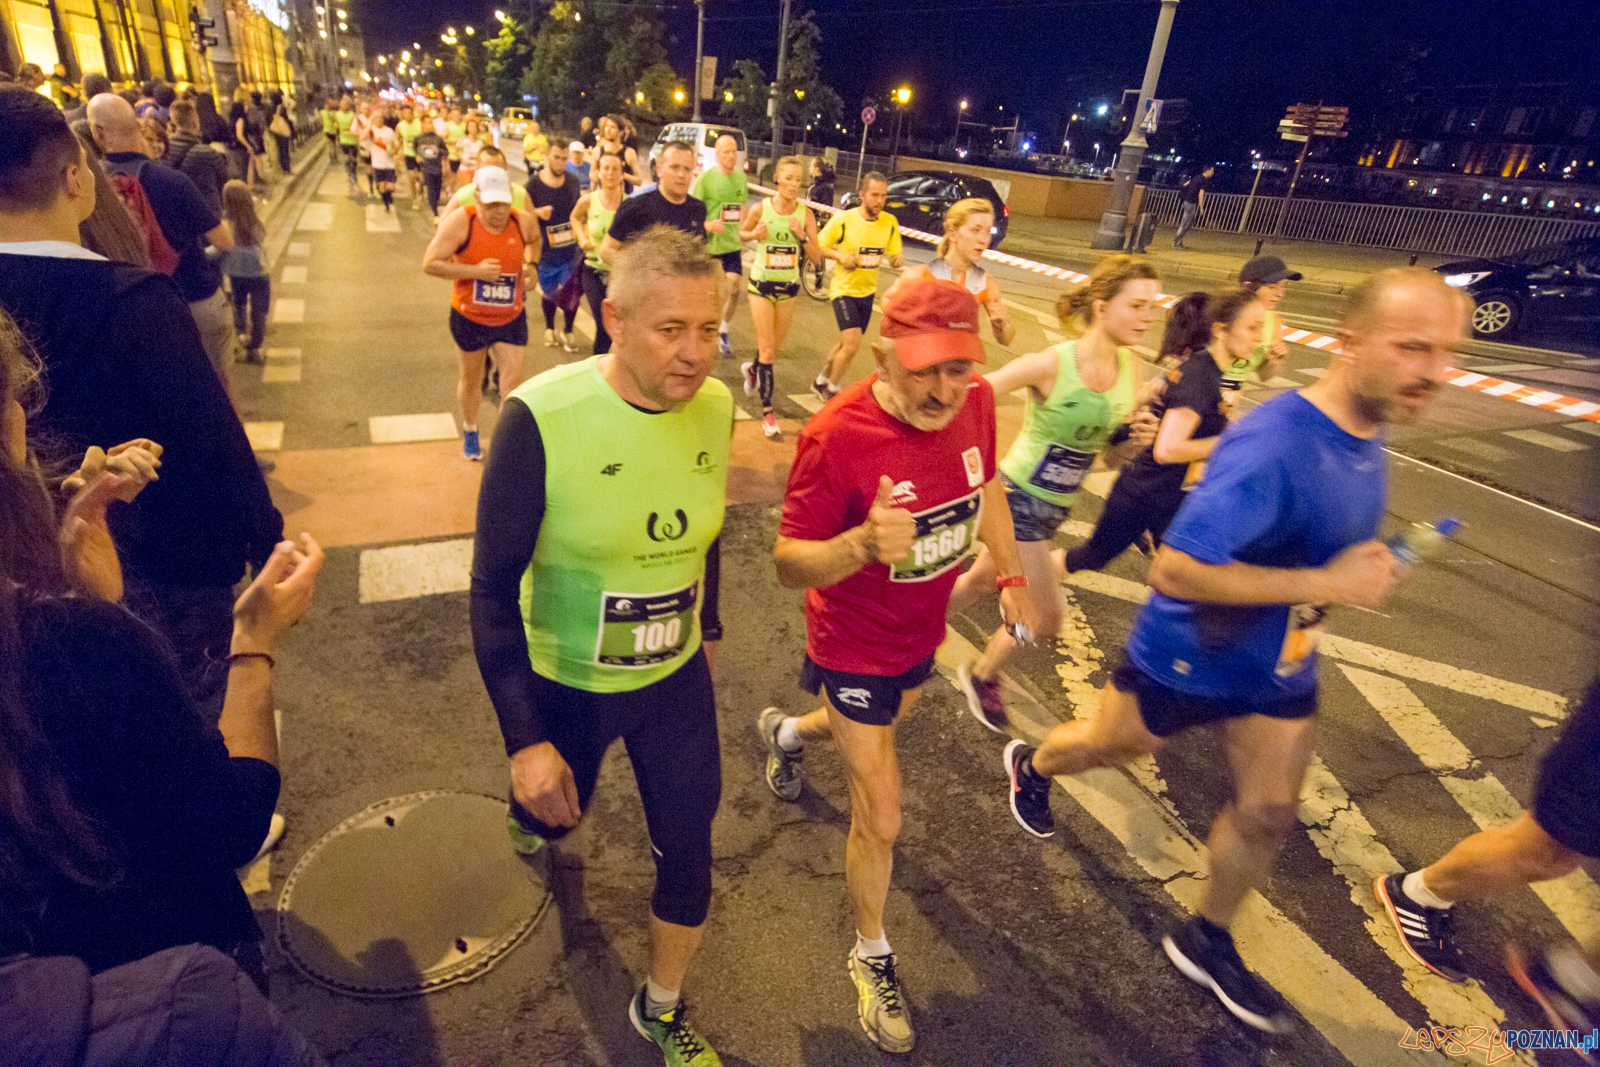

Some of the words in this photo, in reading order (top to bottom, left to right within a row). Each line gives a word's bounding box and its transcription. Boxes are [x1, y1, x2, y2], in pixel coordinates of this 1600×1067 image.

[482, 284, 511, 299] 3145
[600, 463, 623, 476] 4F
[911, 523, 968, 567] 1560
[631, 617, 682, 653] 100
